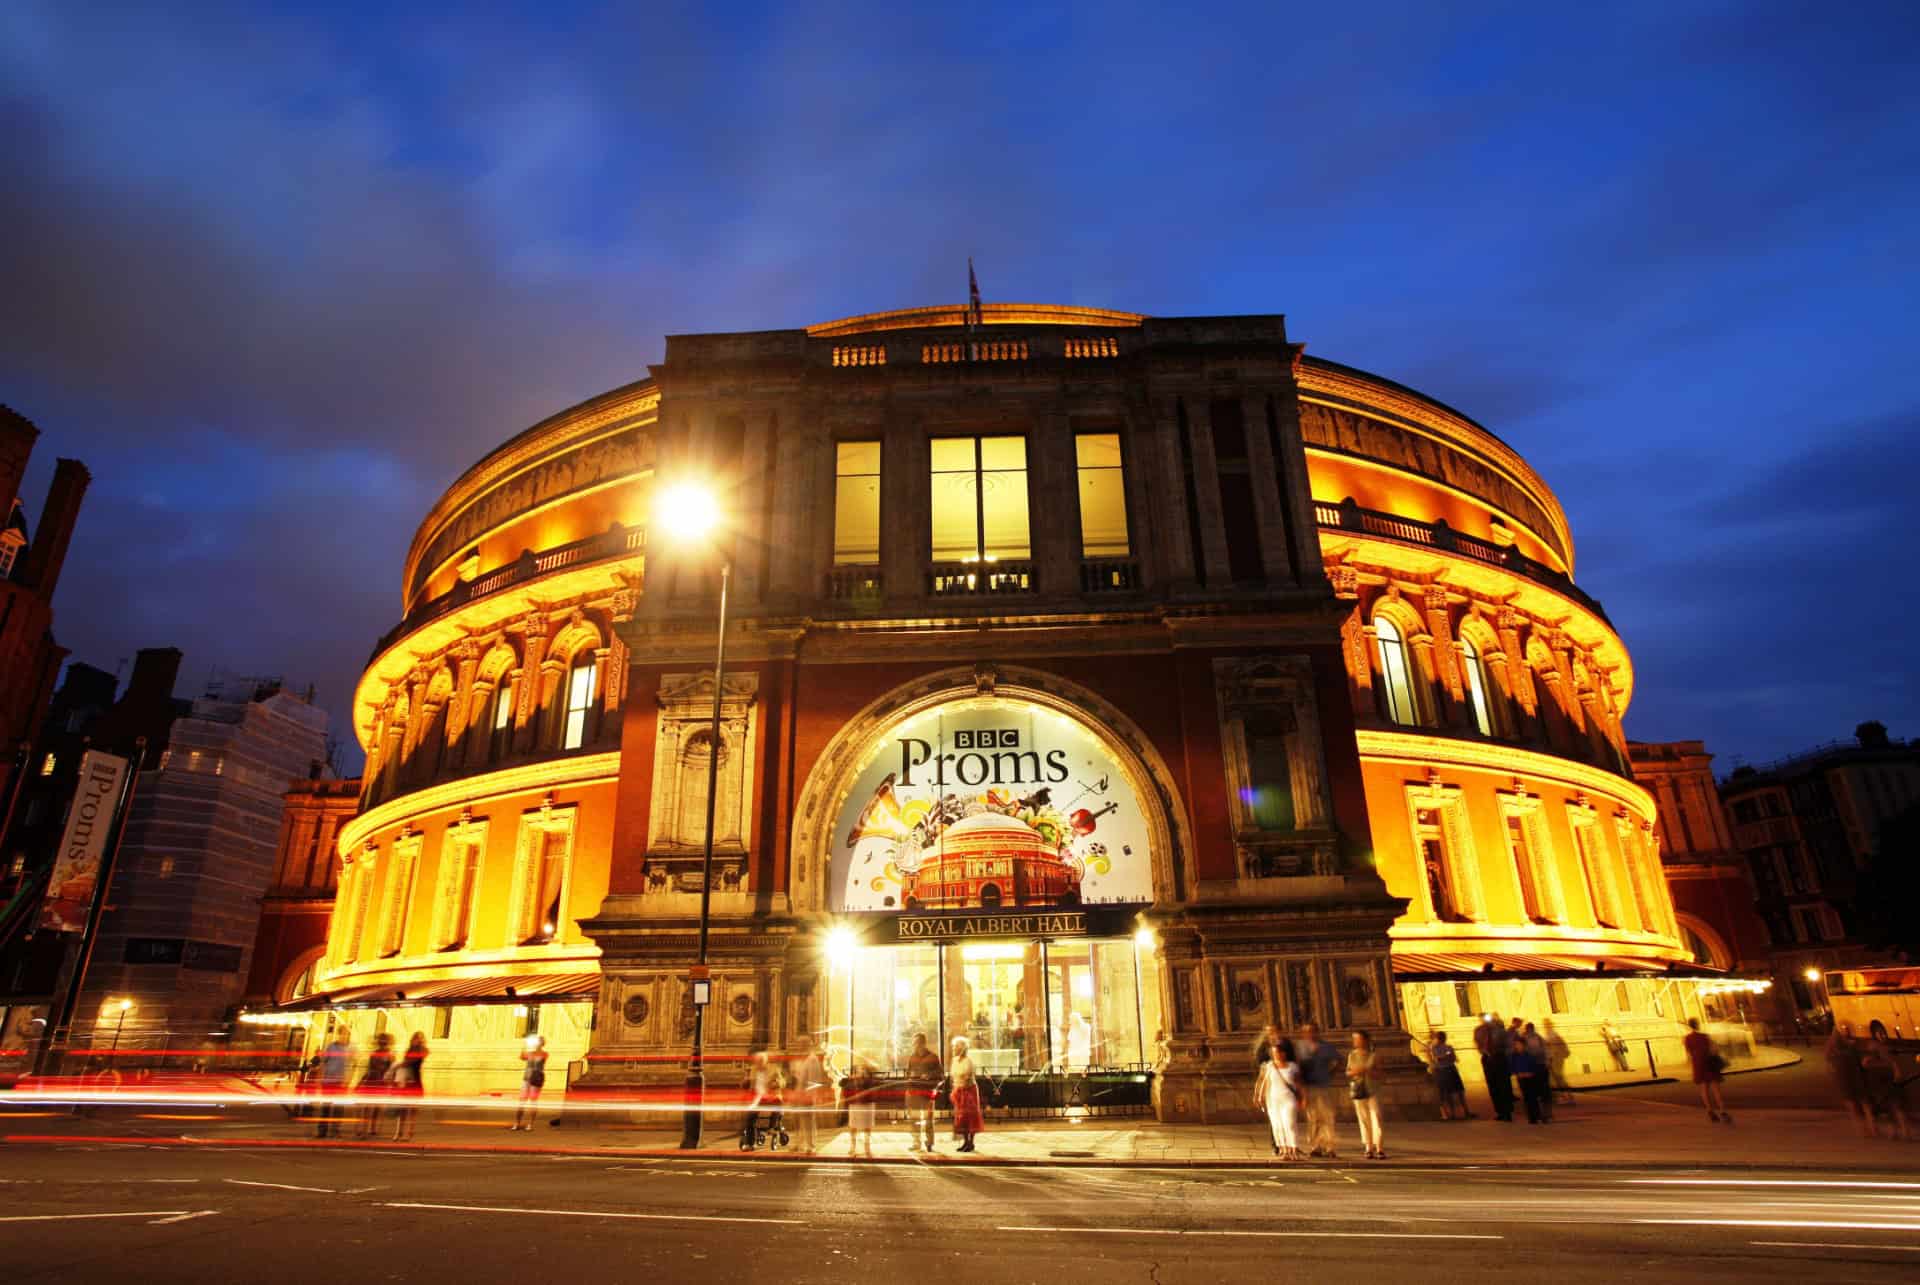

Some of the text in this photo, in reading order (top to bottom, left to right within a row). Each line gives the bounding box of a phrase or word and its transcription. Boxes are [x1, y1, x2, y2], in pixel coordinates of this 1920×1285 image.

[956, 730, 1018, 748] BBC
[896, 738, 1069, 787] Proms
[69, 771, 115, 860] Proms
[899, 916, 1086, 936] ROYAL ALBERT HALL
